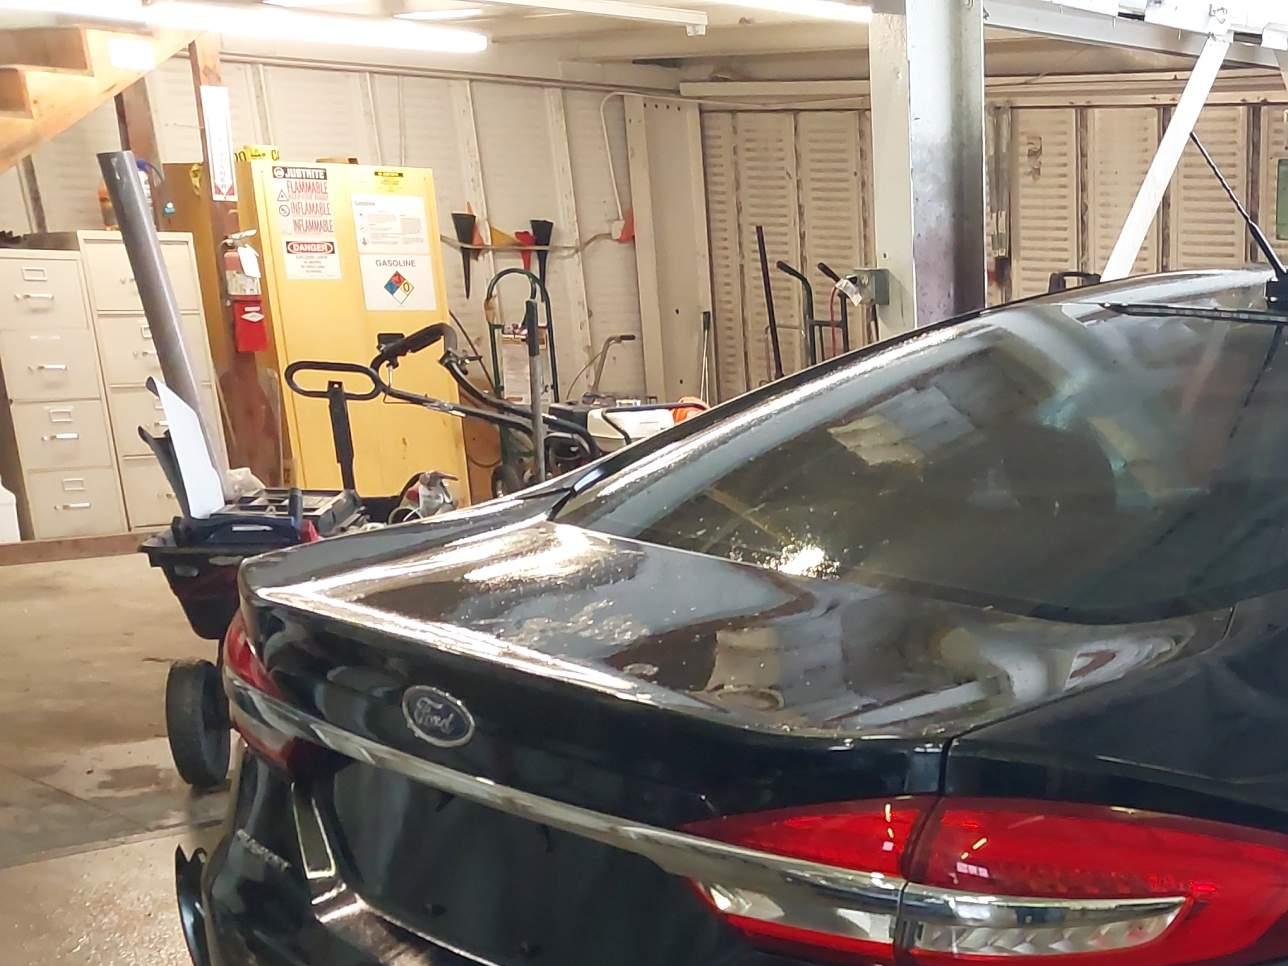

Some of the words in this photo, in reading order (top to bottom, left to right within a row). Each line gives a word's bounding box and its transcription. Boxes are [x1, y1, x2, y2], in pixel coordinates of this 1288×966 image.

[285, 168, 325, 179] JUSTRITE
[286, 180, 328, 194] FLAMMABLE
[291, 201, 331, 215] INFLAMABLE
[293, 218, 334, 232] INFLAMMABLE
[293, 243, 328, 253] DANGER
[375, 259, 416, 268] GASOLINE
[414, 697, 454, 735] Ford
